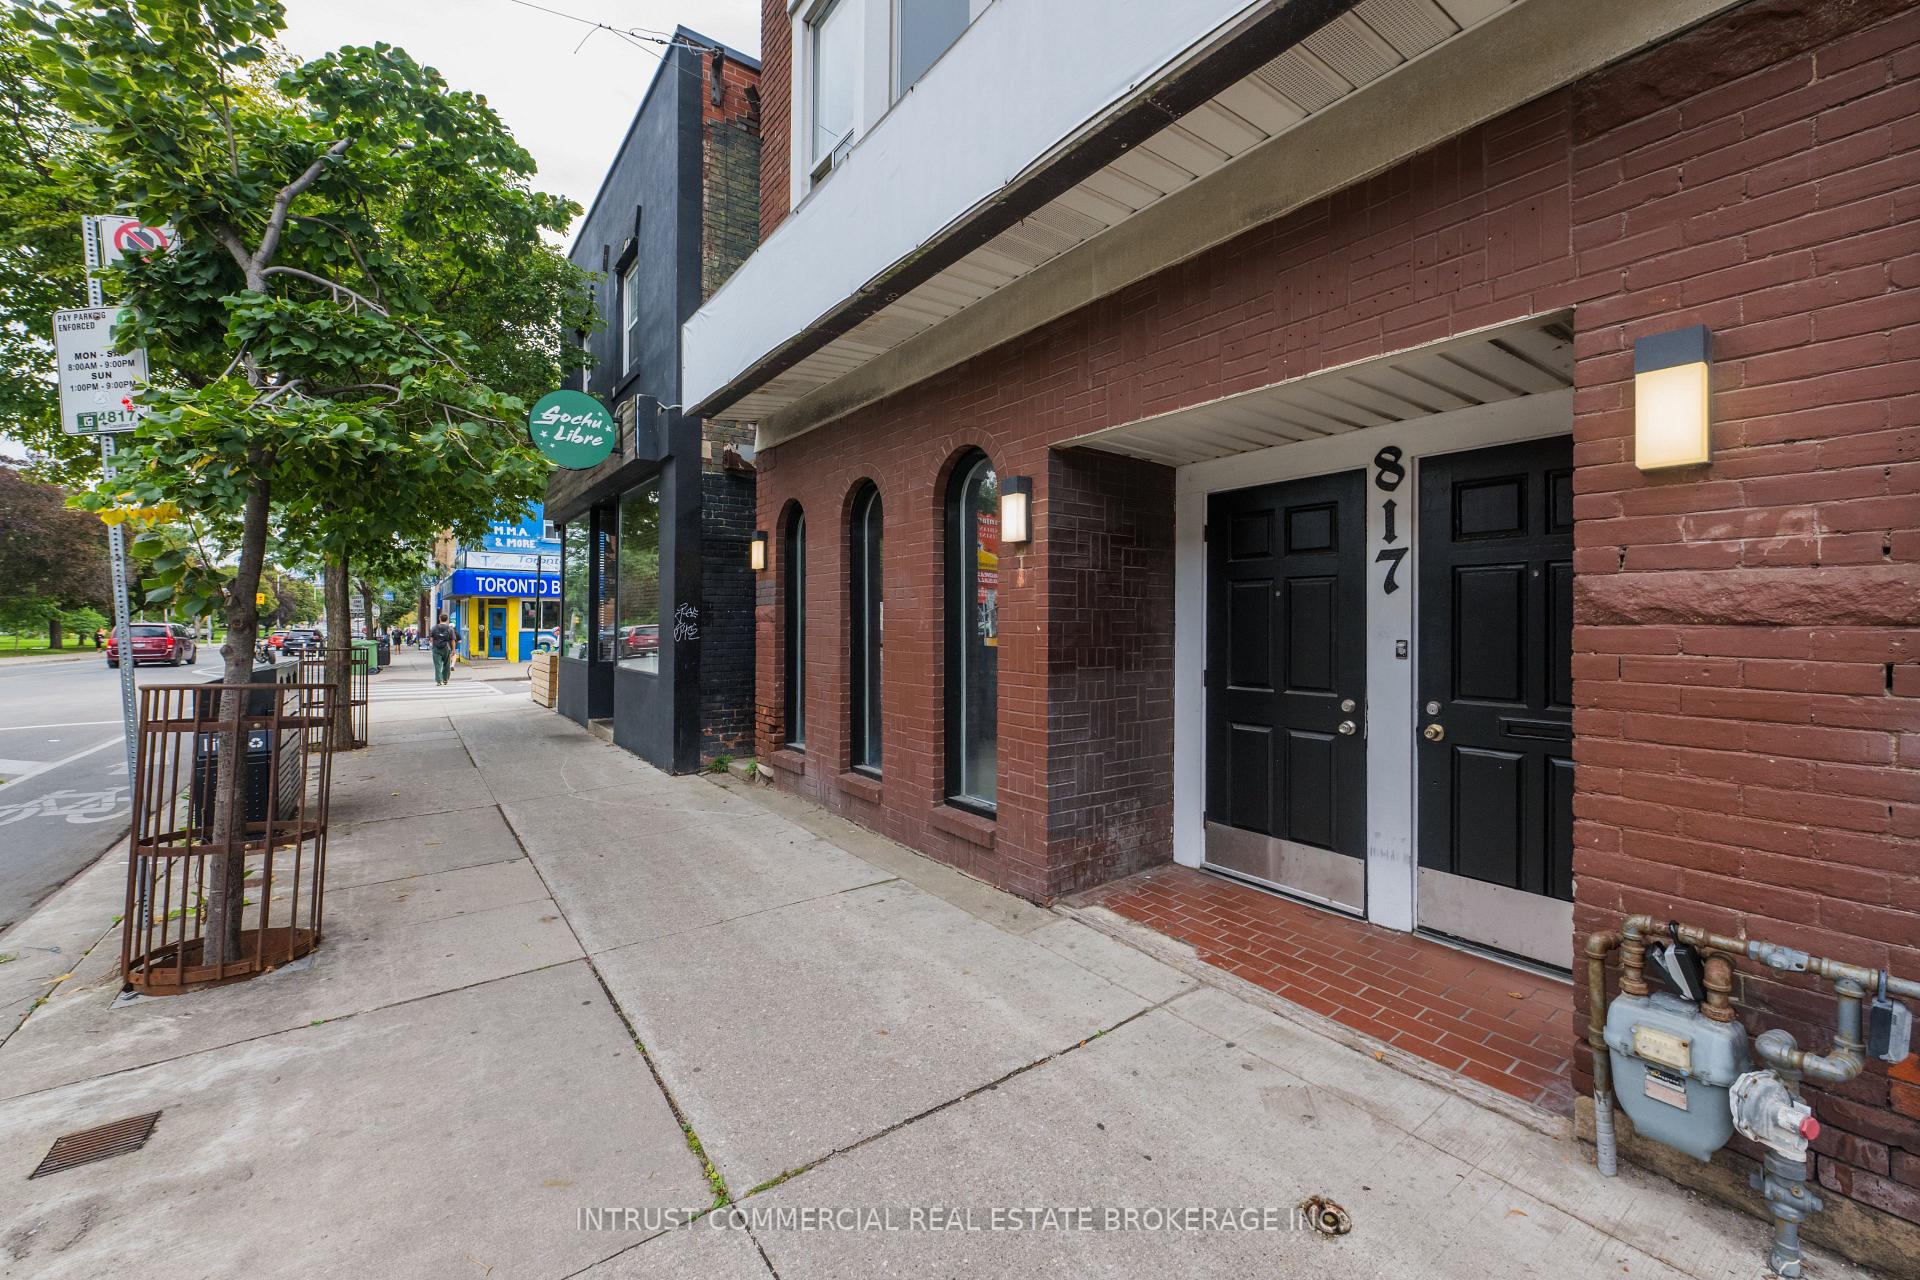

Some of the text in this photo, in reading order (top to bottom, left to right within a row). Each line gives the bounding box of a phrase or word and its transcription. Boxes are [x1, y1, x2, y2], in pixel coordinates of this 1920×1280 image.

[57, 311, 106, 322] PAY PARKG
[58, 321, 95, 332] ENFORCED
[74, 352, 97, 360] MON
[107, 350, 124, 358] SA
[68, 362, 97, 371] 8:00AM
[104, 359, 135, 368] 9:00PM
[91, 371, 112, 380] SUN
[70, 383, 99, 392] 1:00PM
[106, 380, 136, 390] 9:00PM
[98, 410, 135, 423] 4817
[553, 425, 604, 446] Libre
[1374, 445, 1409, 595] 817
[493, 525, 531, 537] M.M.A.
[495, 537, 536, 549] & MORE
[476, 576, 548, 594] TORONTO
